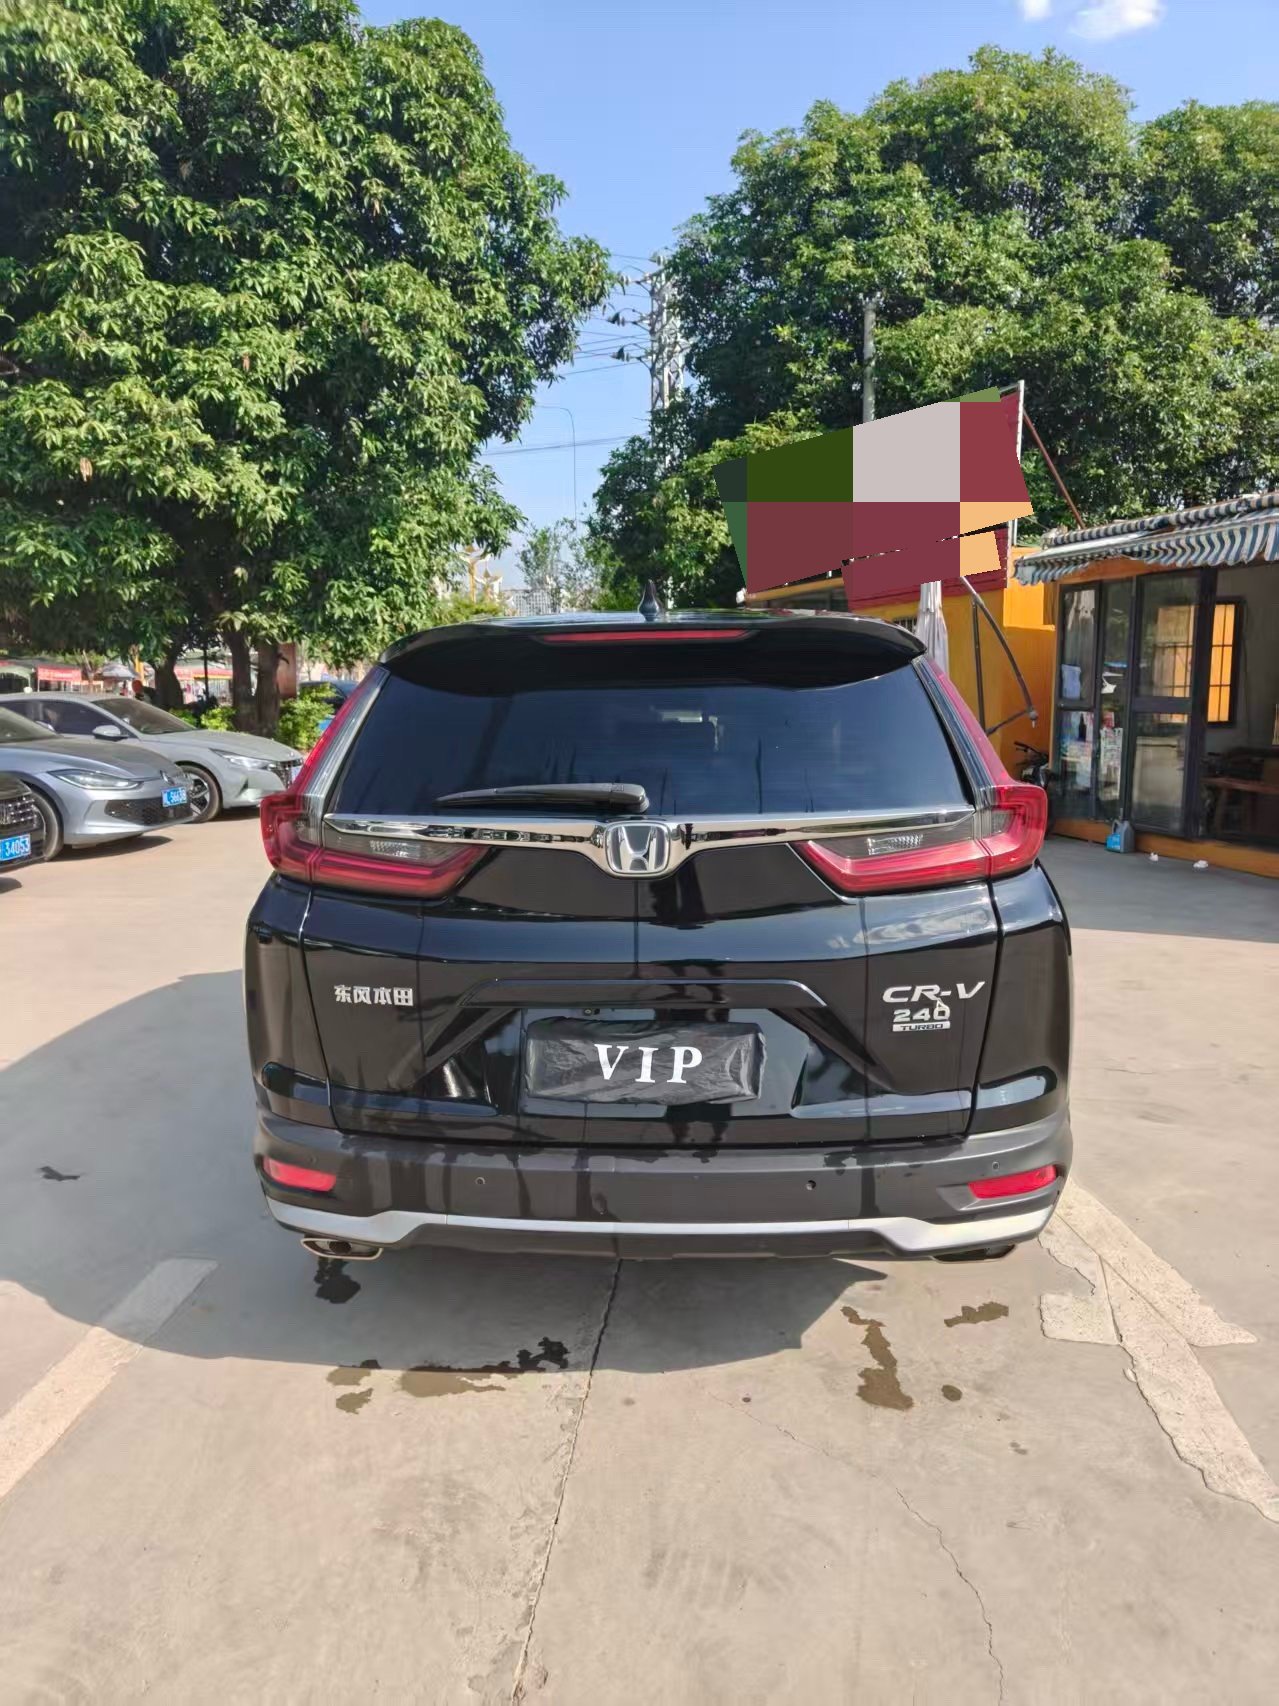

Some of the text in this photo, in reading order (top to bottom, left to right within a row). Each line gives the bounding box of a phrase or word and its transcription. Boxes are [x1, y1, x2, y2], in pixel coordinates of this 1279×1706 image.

[333, 984, 414, 1007] 东风本田
[882, 980, 986, 1003] CR-V
[594, 1043, 703, 1084] VIP
